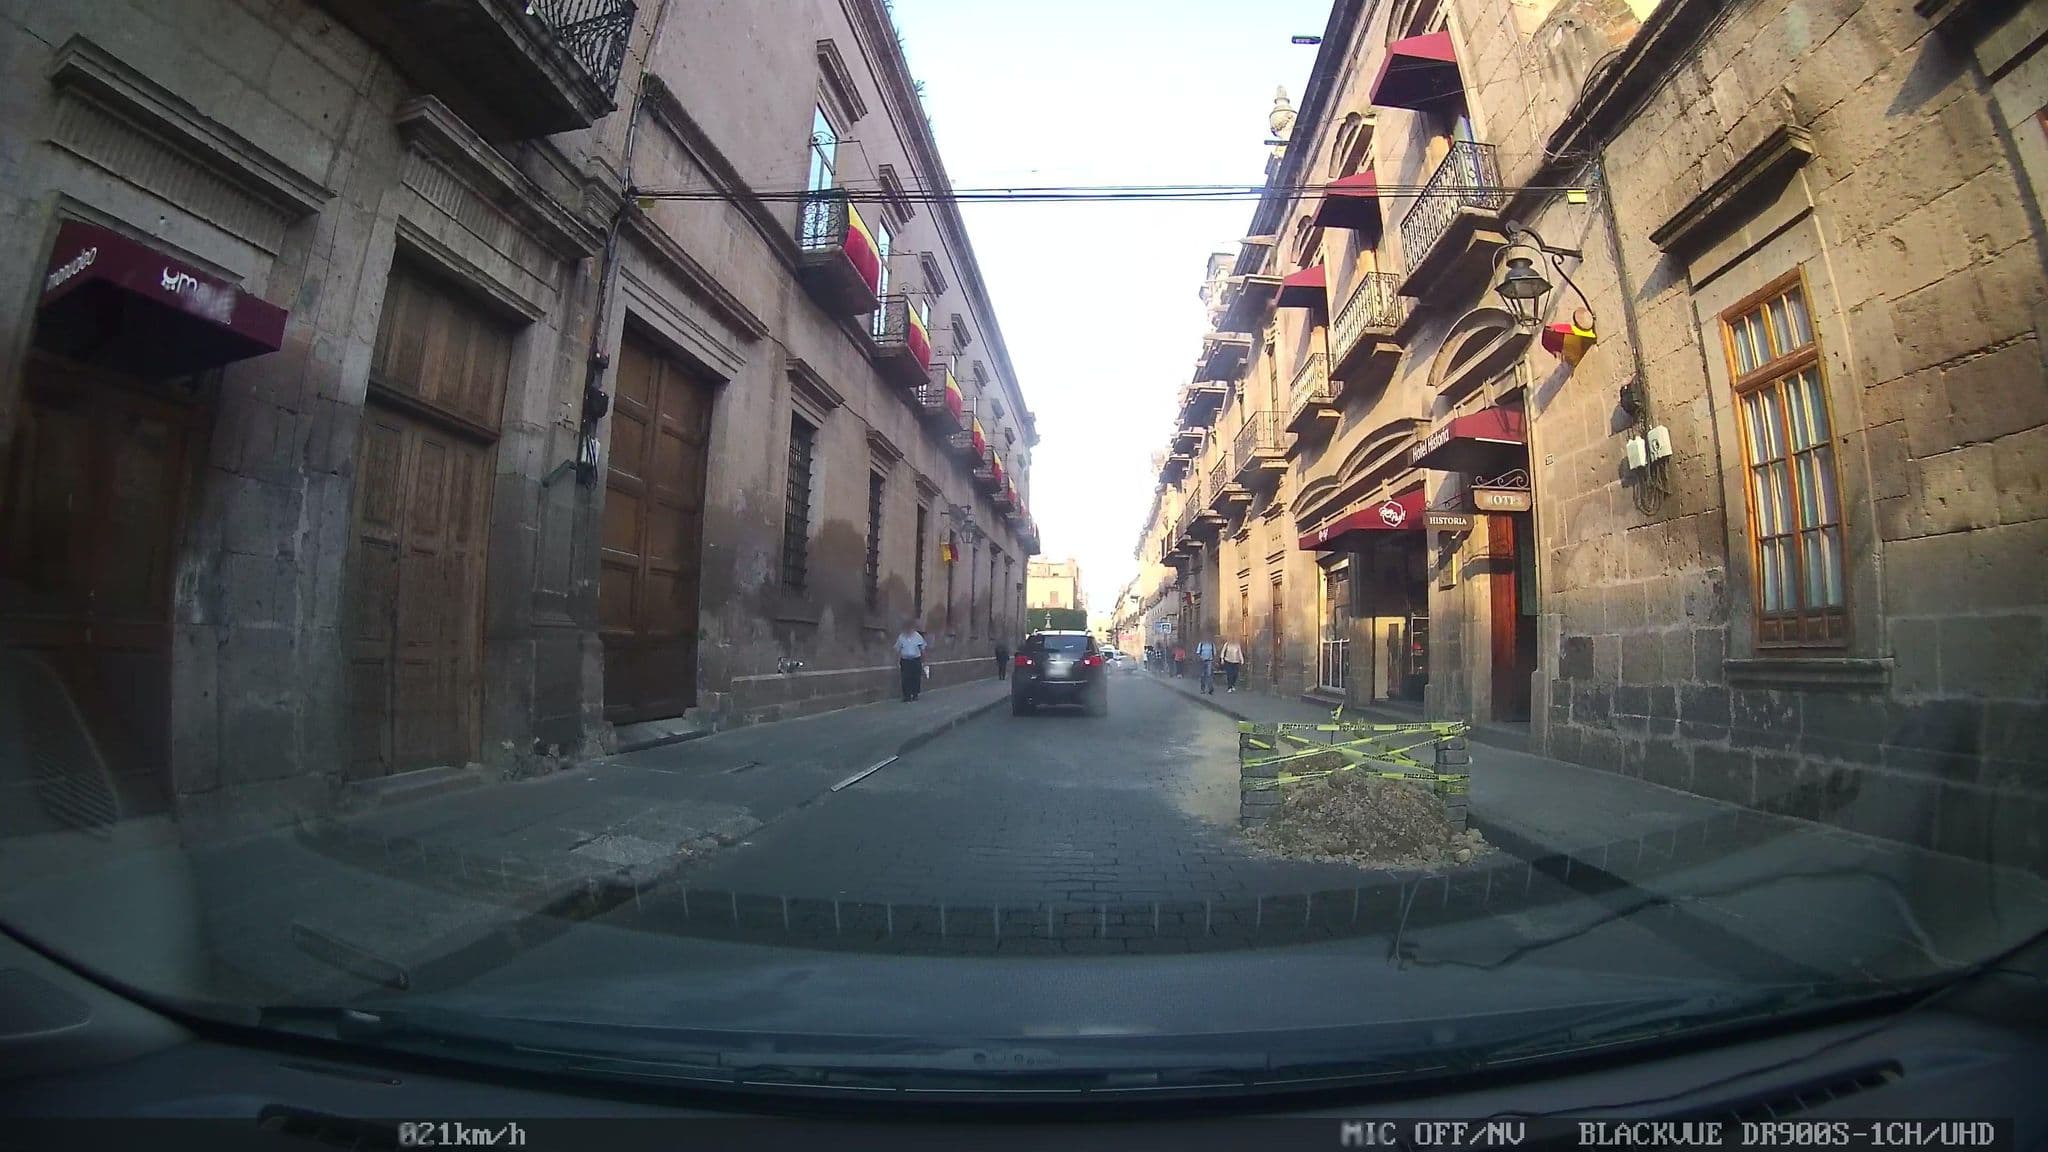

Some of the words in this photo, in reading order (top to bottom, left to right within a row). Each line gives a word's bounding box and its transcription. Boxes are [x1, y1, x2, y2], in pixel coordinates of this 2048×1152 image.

[1412, 439, 1428, 463] Hotel
[1427, 426, 1450, 453] Historia
[1429, 516, 1467, 526] HISTORIA
